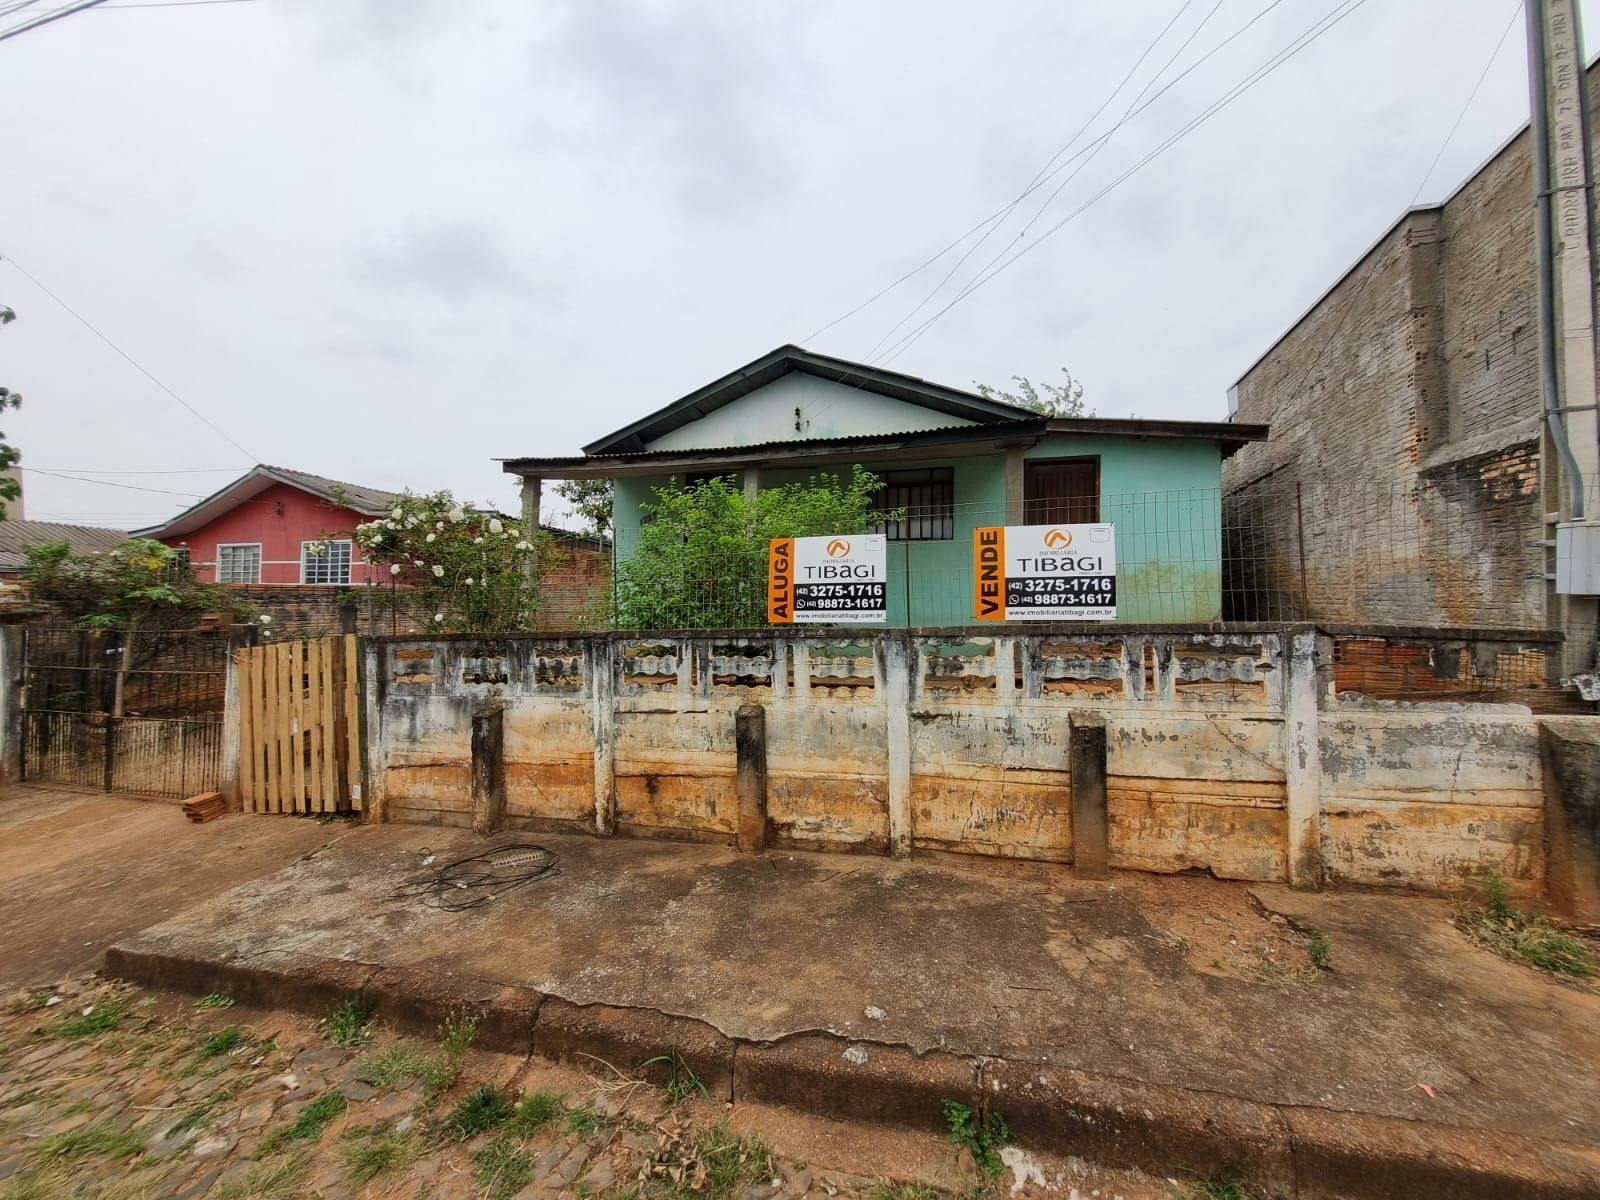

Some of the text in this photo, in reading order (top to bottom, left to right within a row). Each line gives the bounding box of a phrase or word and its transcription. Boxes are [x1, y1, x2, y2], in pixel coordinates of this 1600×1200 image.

[981, 531, 999, 615] VENDE
[774, 542, 789, 619] ALUGA
[1008, 578, 1112, 592] (42) 3275-1716
[796, 585, 883, 597] (42) 3275-1716
[817, 598, 883, 608] 98873-1617
[1034, 594, 1112, 604] 98873-1617
[1008, 609, 1113, 617] www.imobiliariatibagi.com.br
